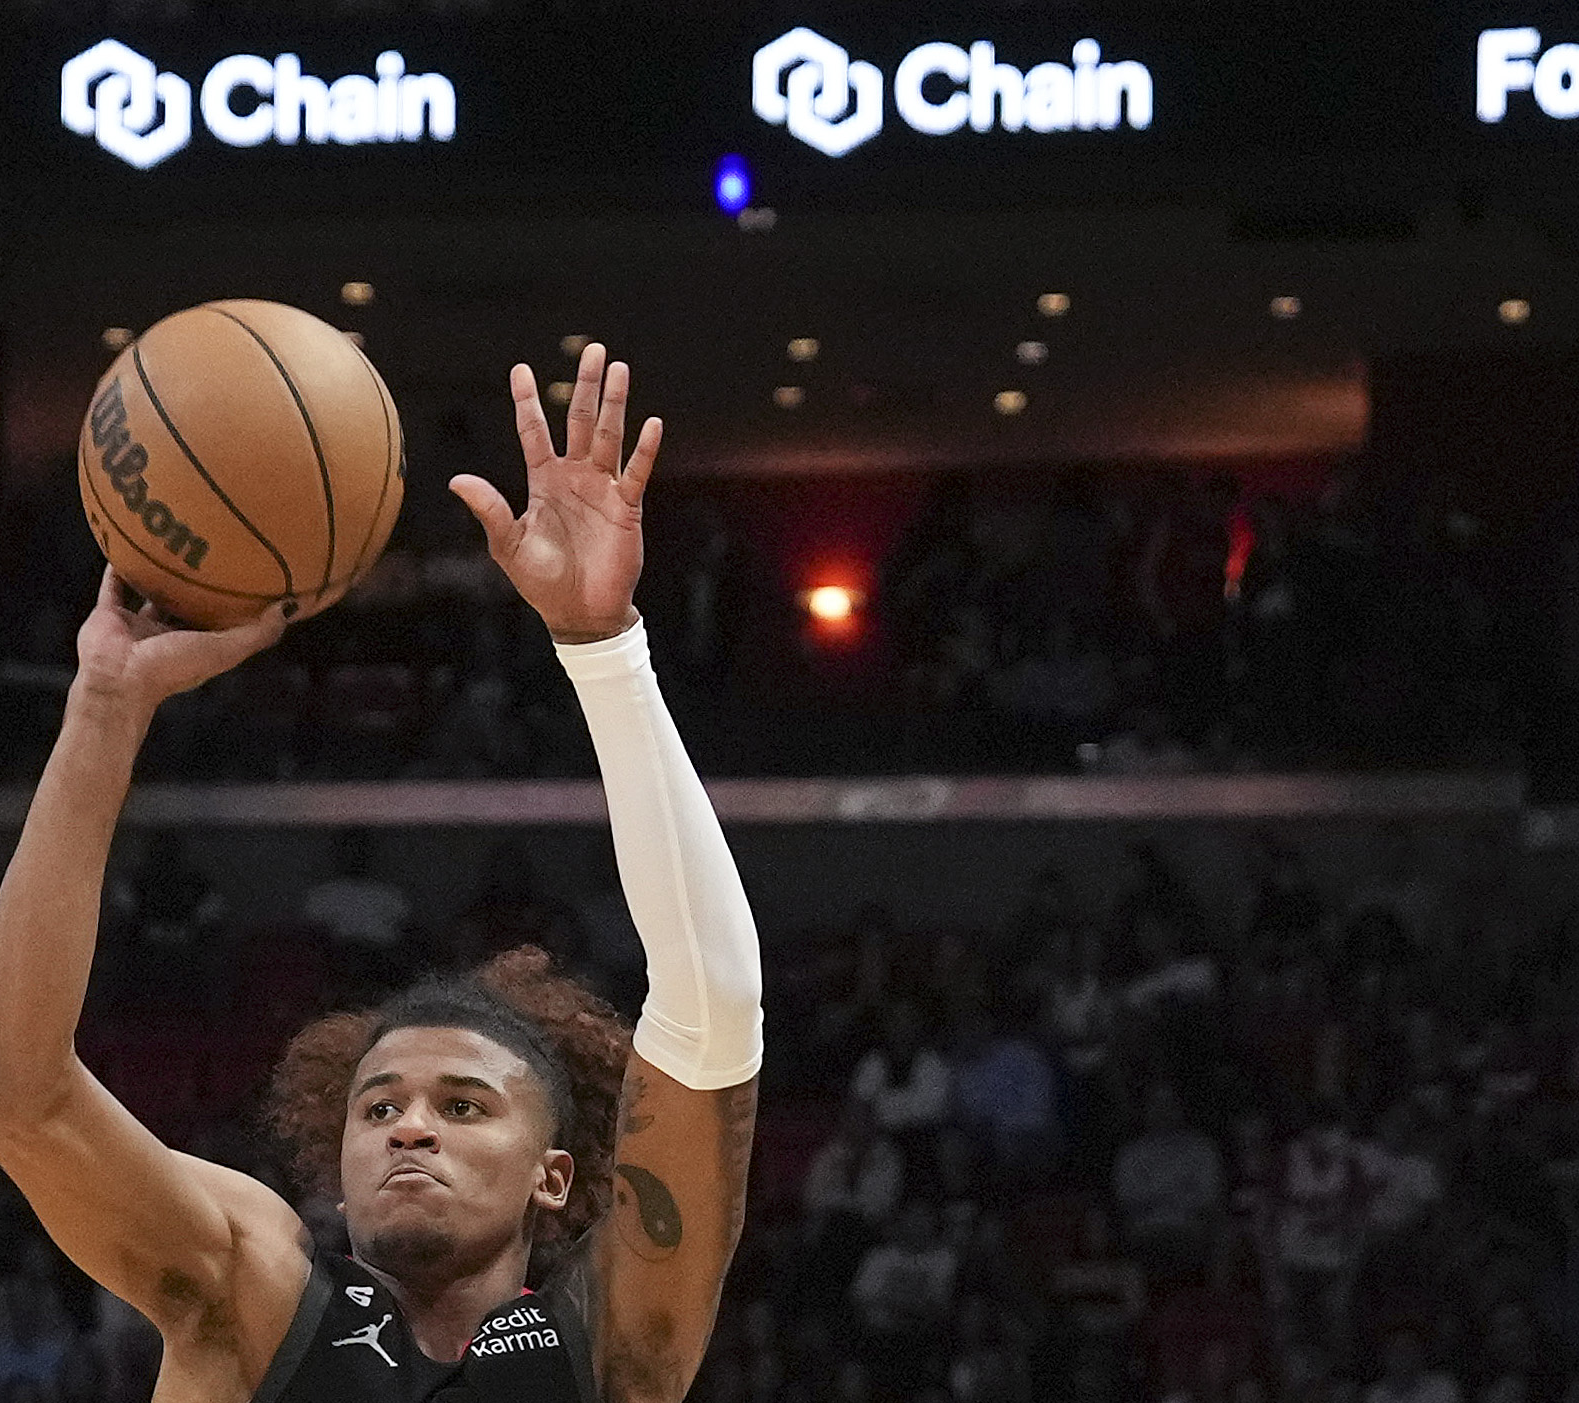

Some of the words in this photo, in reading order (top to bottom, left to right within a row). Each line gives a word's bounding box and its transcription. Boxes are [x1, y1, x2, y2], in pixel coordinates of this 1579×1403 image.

[200, 50, 457, 146] Chain
[894, 38, 1154, 136] Chain
[90, 375, 210, 571] Wilson
[470, 1328, 560, 1357] karma
